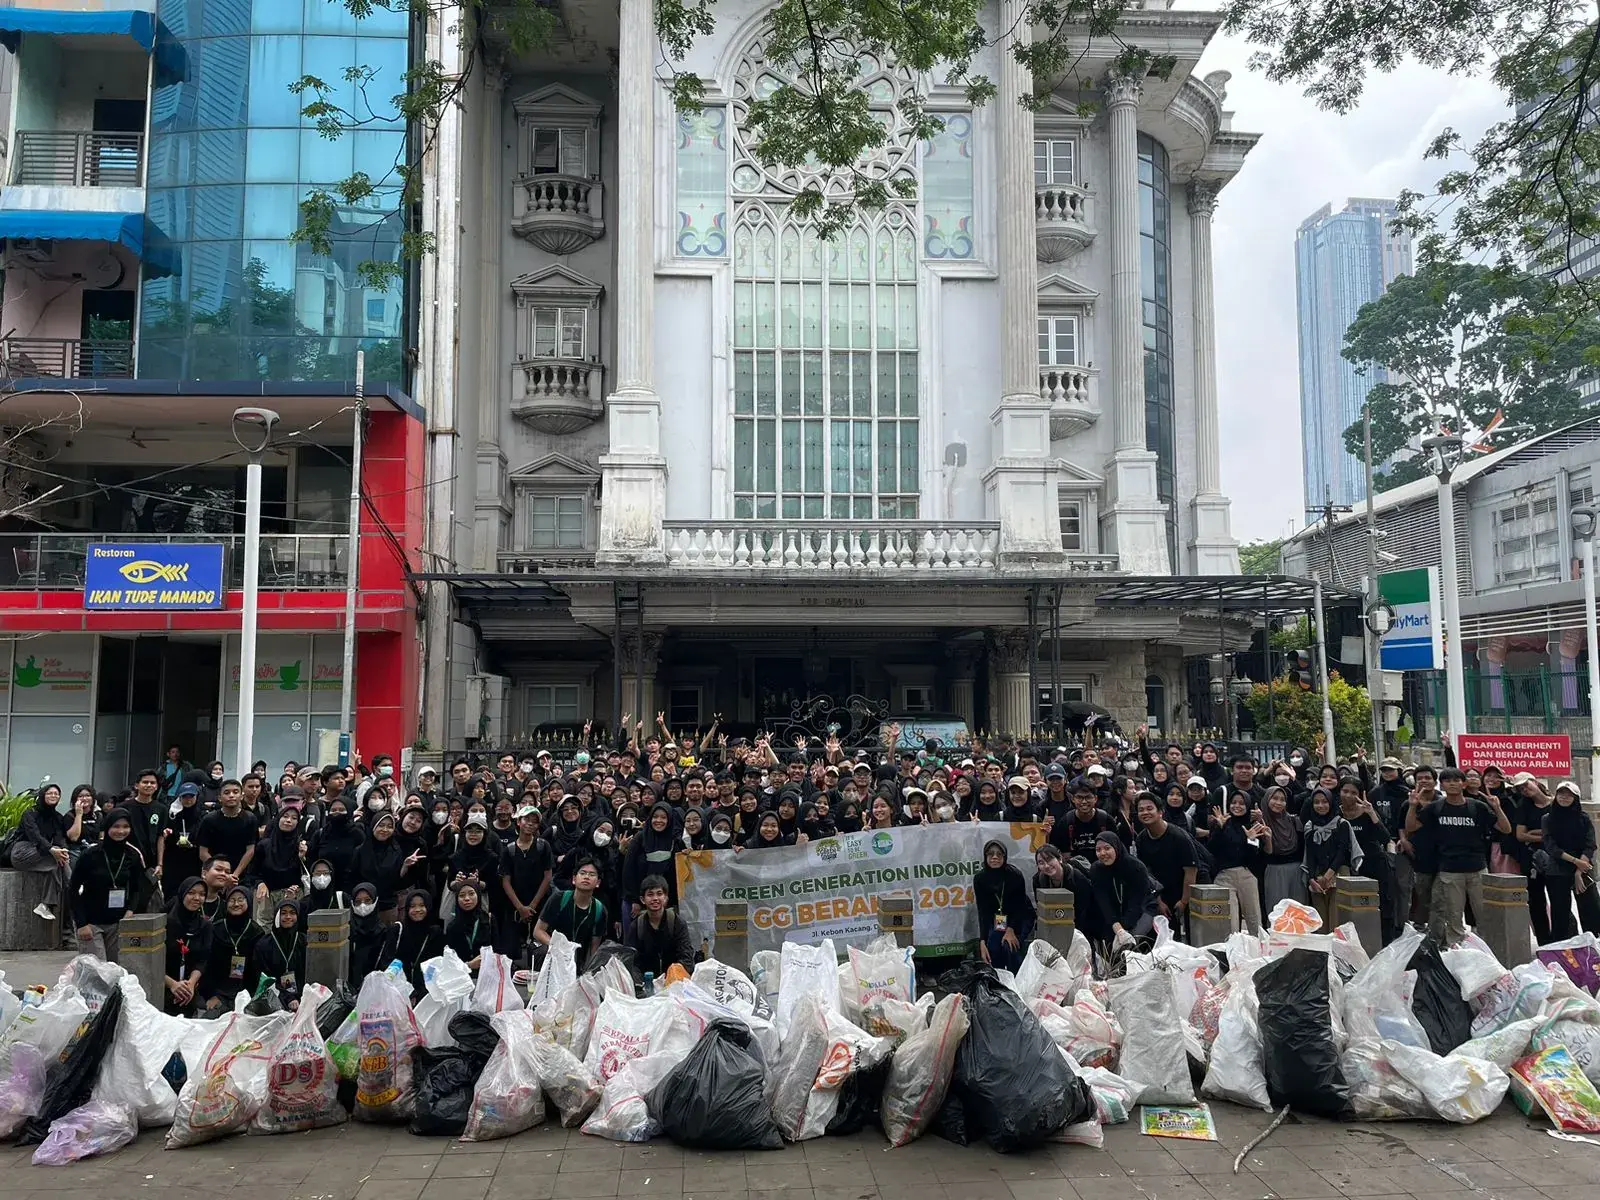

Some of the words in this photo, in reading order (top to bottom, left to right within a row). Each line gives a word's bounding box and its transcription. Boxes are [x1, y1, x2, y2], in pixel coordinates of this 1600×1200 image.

[94, 548, 135, 558] Restoran
[88, 590, 122, 604] IKAN
[124, 590, 158, 604] TUDE
[158, 590, 215, 604] MANADO
[1464, 741, 1513, 749] DILARANG
[1514, 742, 1561, 750] BERHENTI
[1473, 750, 1493, 758] DAN
[1495, 751, 1549, 759] BERJUALAN
[1461, 759, 1471, 767] DI
[1473, 759, 1527, 768] SEPANJANG
[1528, 760, 1554, 768] AREA
[1555, 760, 1569, 768] INI
[847, 840, 862, 848] EASY
[721, 883, 785, 900] GREEN
[789, 866, 909, 895] GENERATION
[913, 860, 985, 879] INDONE
[754, 906, 792, 929] GG
[821, 928, 844, 937] Kebon
[845, 925, 874, 936] Kacang,
